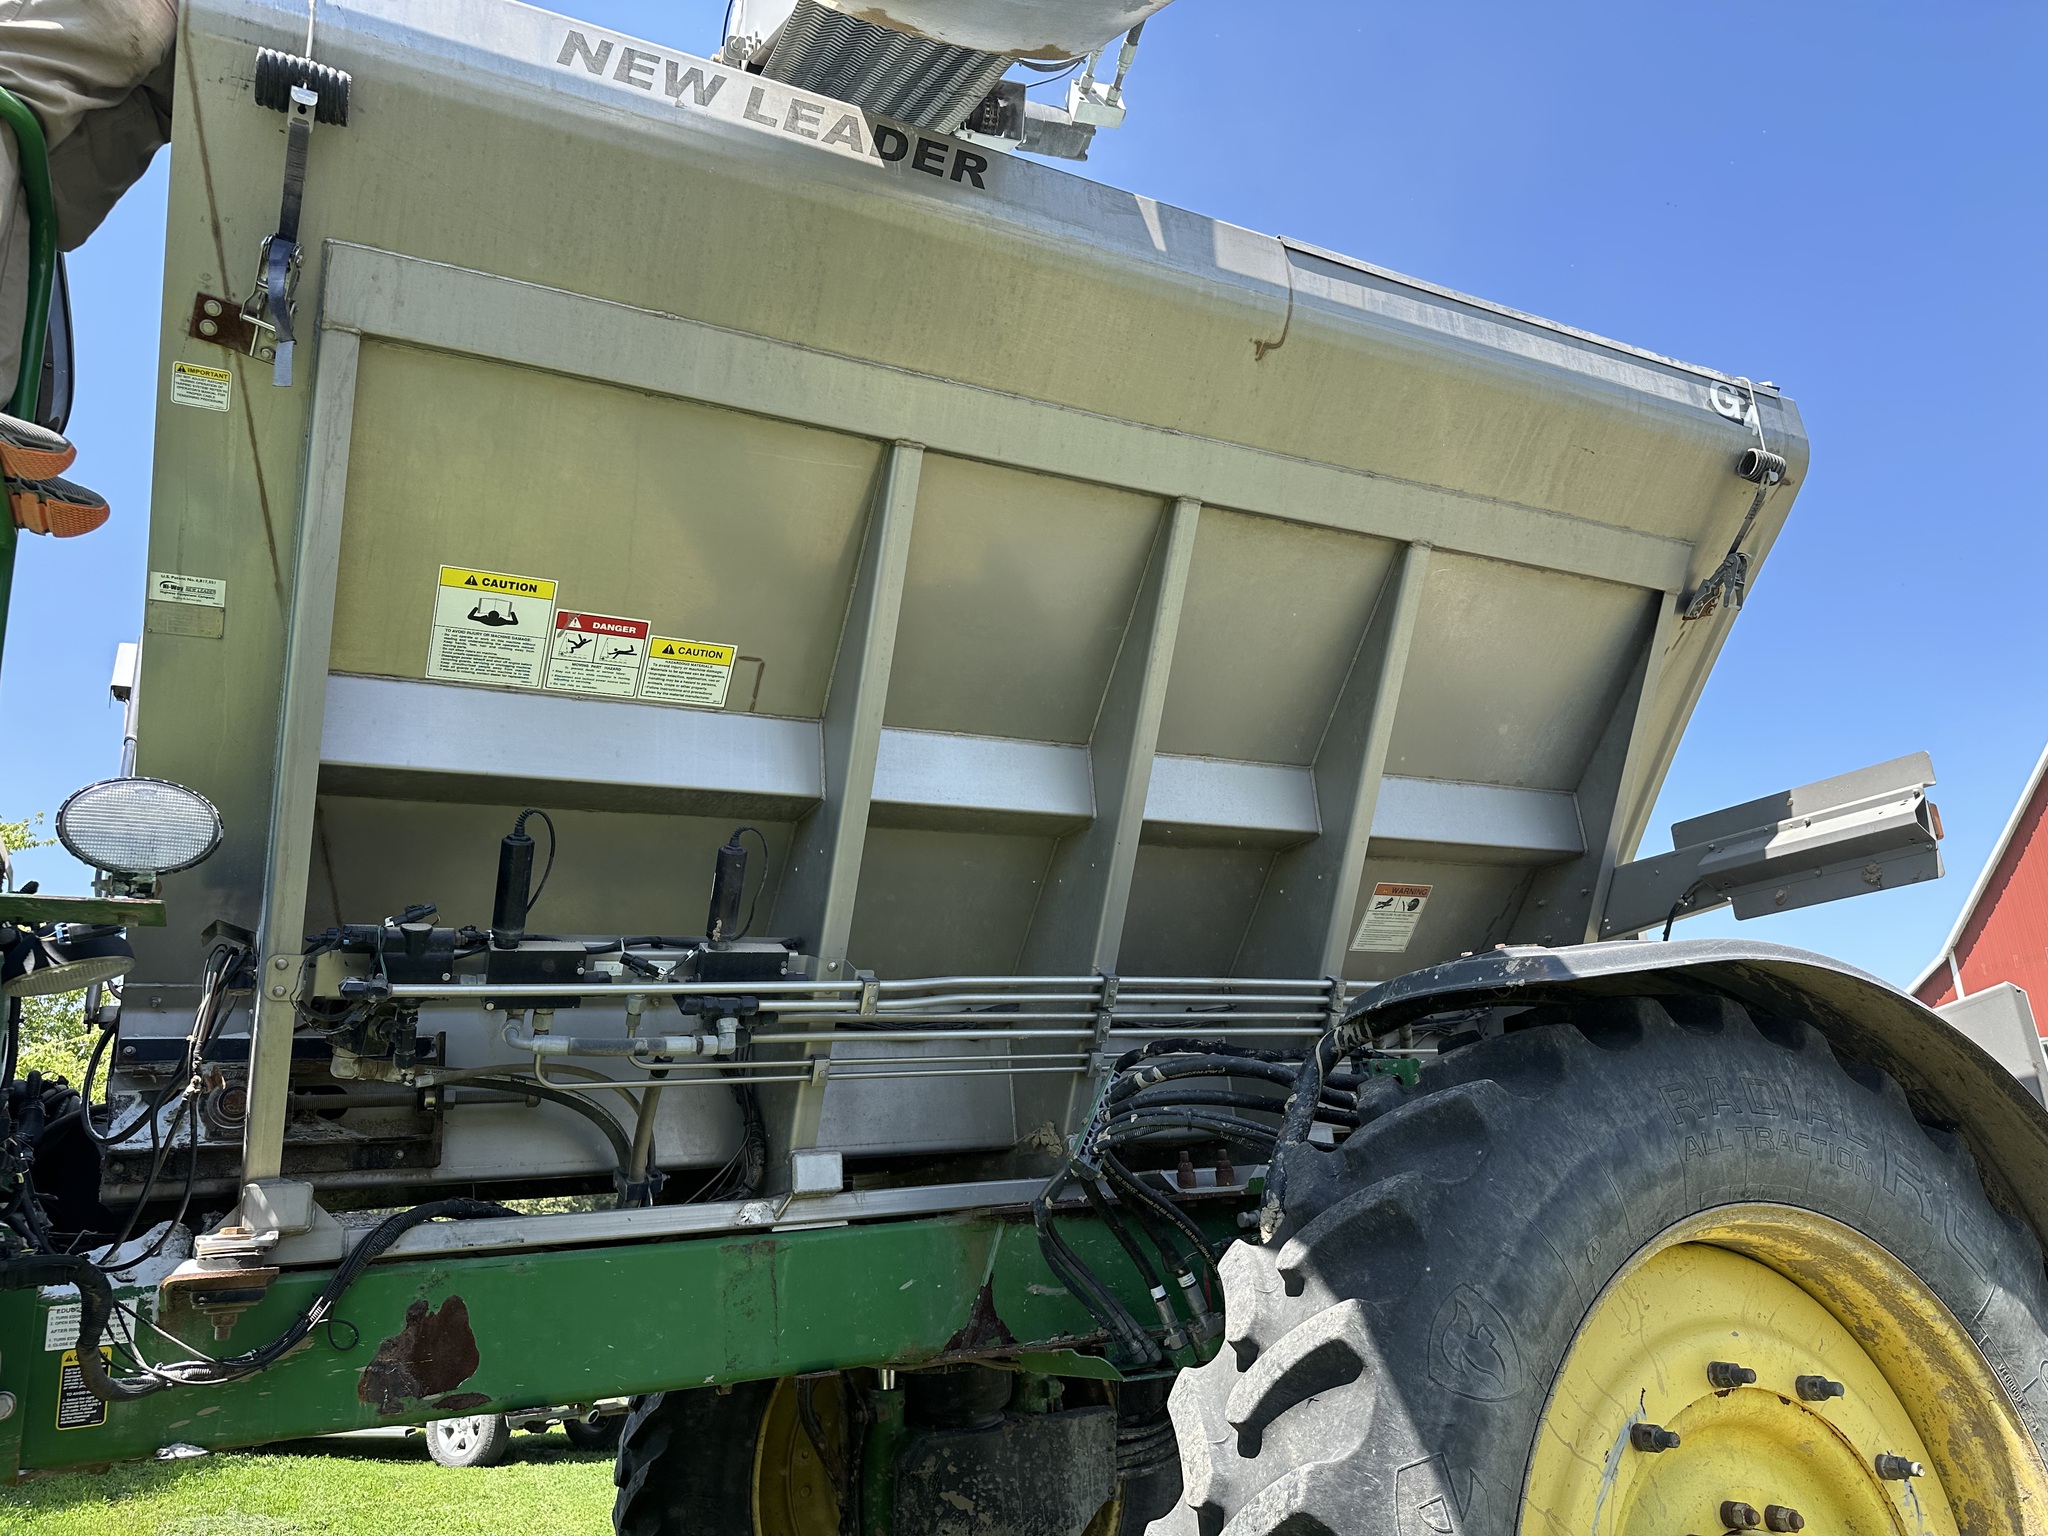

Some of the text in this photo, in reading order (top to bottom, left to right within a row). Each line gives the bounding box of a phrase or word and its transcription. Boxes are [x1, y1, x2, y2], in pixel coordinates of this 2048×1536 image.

[556, 29, 990, 191] NEW LEADER
[187, 367, 228, 380] IMPORTANT
[482, 577, 538, 593] CAUTION
[592, 622, 636, 634] DANGER
[678, 646, 723, 660] CAUTION
[1391, 887, 1428, 896] WARNING
[1657, 1075, 1870, 1150] RADIAL
[1684, 1125, 1875, 1183] ALL TRACTION
[1176, 1220, 1186, 1230] SAE
